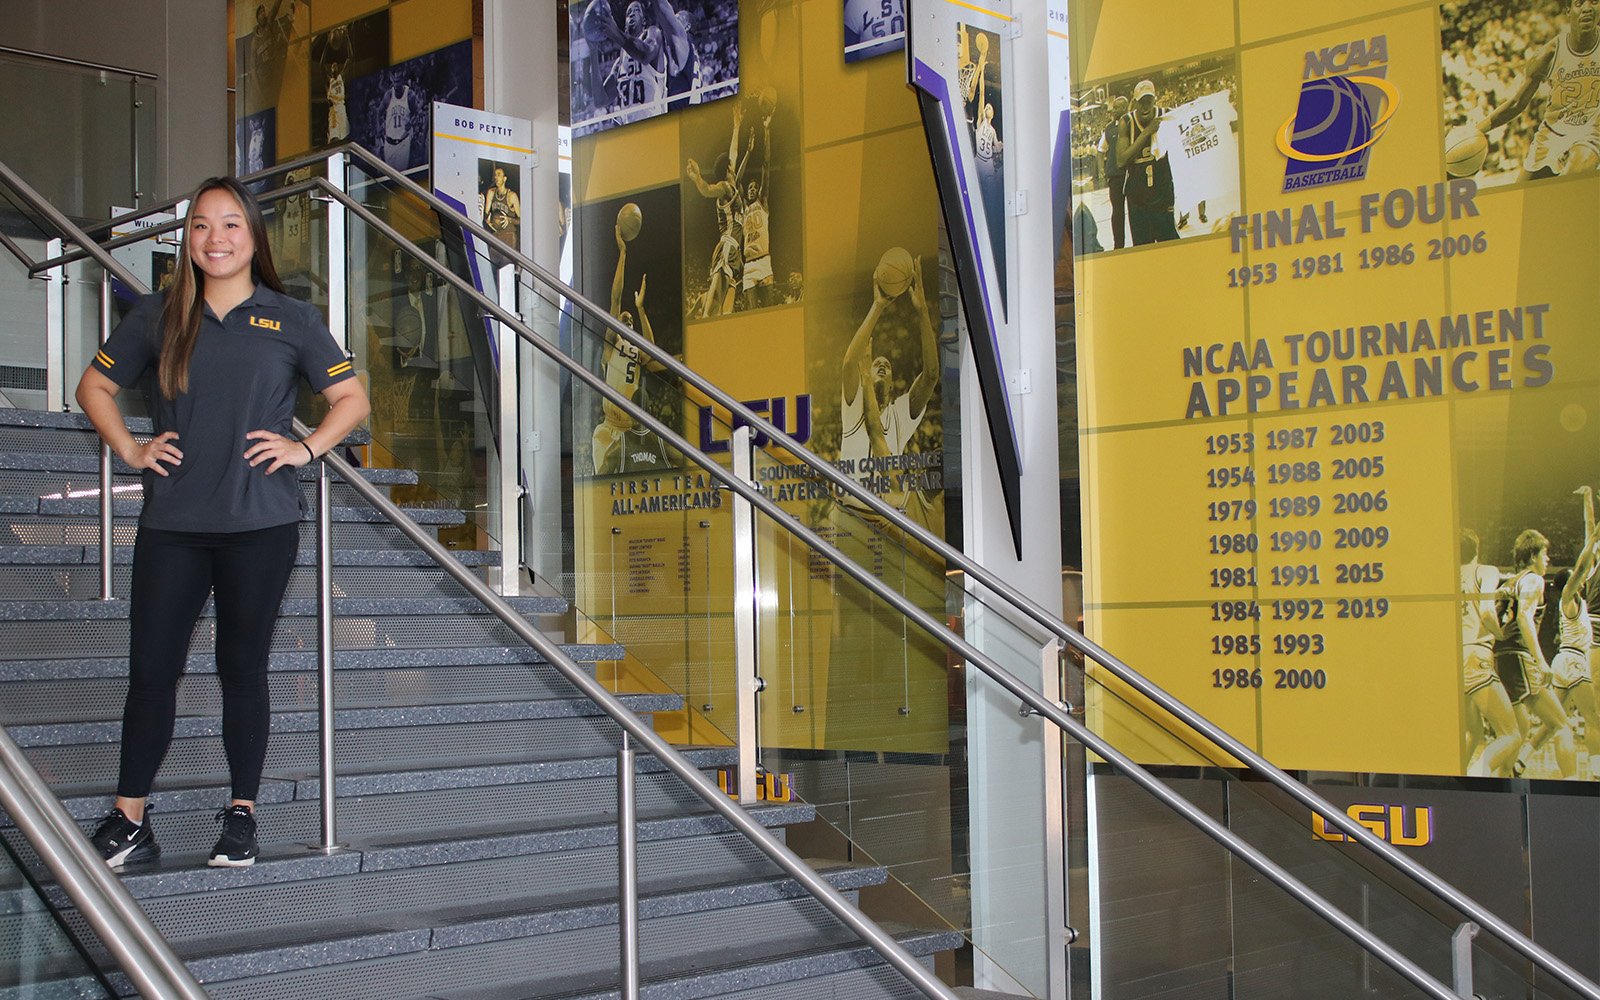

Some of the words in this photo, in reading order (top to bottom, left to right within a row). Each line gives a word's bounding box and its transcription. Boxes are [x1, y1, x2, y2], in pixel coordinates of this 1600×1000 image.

[1303, 35, 1389, 80] NCAA
[454, 118, 475, 130] BOB
[479, 122, 513, 137] PETTIT
[1178, 109, 1214, 135] LSU
[1184, 134, 1219, 159] TIGERS
[1284, 164, 1364, 191] BASKETBALL
[1230, 200, 1347, 254] FINAL
[1360, 178, 1481, 234] FOUR
[1227, 262, 1278, 289] 1953
[1291, 252, 1344, 280] 1981
[1359, 242, 1416, 270] 1986
[1427, 230, 1488, 261] 2006
[250, 315, 281, 331] LSU
[1183, 338, 1274, 377] NCAA
[1284, 304, 1550, 366] TOURNAMENT
[626, 361, 637, 384] 5
[1185, 344, 1555, 419] APPEARANCES
[1206, 432, 1255, 455] 1953
[1266, 427, 1318, 450] 1987
[1330, 421, 1385, 445] 2003
[631, 452, 656, 464] THOMAS
[859, 449, 942, 473] CONFERENCE
[1207, 466, 1256, 488] 1954
[1267, 461, 1321, 484] 1988
[1331, 456, 1384, 479] 2005
[611, 479, 661, 496] FIRST
[760, 481, 829, 502] PLAYERS
[860, 475, 890, 493] THE
[896, 471, 942, 491] YEAR
[612, 491, 721, 515] ALL-AMERICANS
[1208, 500, 1257, 521] 1979
[1269, 495, 1320, 518] 1989
[1333, 489, 1388, 514] 2006
[1209, 533, 1258, 555] 1980
[1270, 530, 1321, 552] 1990
[1334, 526, 1389, 548] 2009
[1210, 567, 1258, 589] 1981
[1270, 565, 1320, 587] 1991
[1335, 563, 1384, 584] 2015
[1210, 601, 1261, 622] 1984
[1272, 600, 1324, 621] 1992
[1337, 598, 1389, 618] 2019
[1211, 635, 1261, 655] 1985
[1273, 634, 1324, 655] 1993
[1212, 668, 1263, 689] 1986
[1274, 668, 1326, 689] 2000
